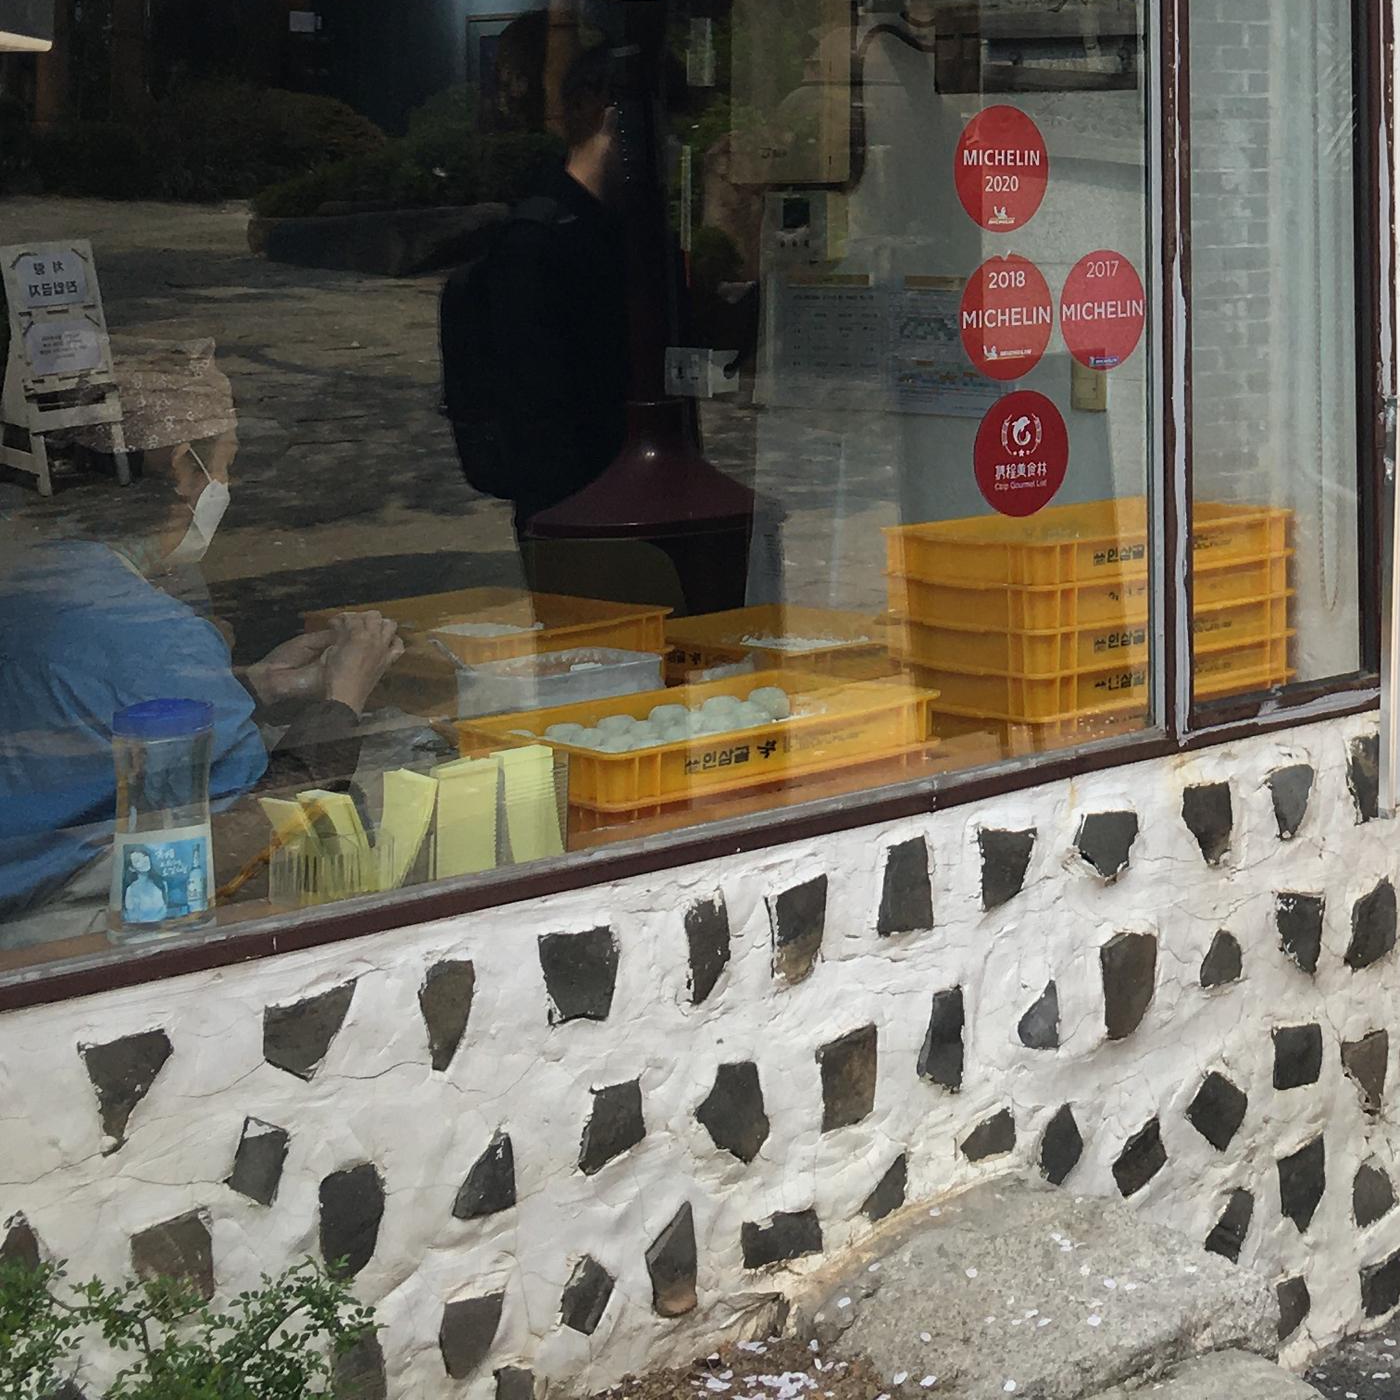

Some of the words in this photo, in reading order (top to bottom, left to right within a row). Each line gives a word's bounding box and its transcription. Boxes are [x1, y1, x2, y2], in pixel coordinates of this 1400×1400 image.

[963, 149, 1041, 167] MICHELIN
[984, 175, 1020, 193] 2020
[1086, 260, 1120, 278] 2017
[988, 270, 1026, 289] 2018
[962, 305, 1051, 330] MICHELIN
[1062, 300, 1144, 322] MICHELIN
